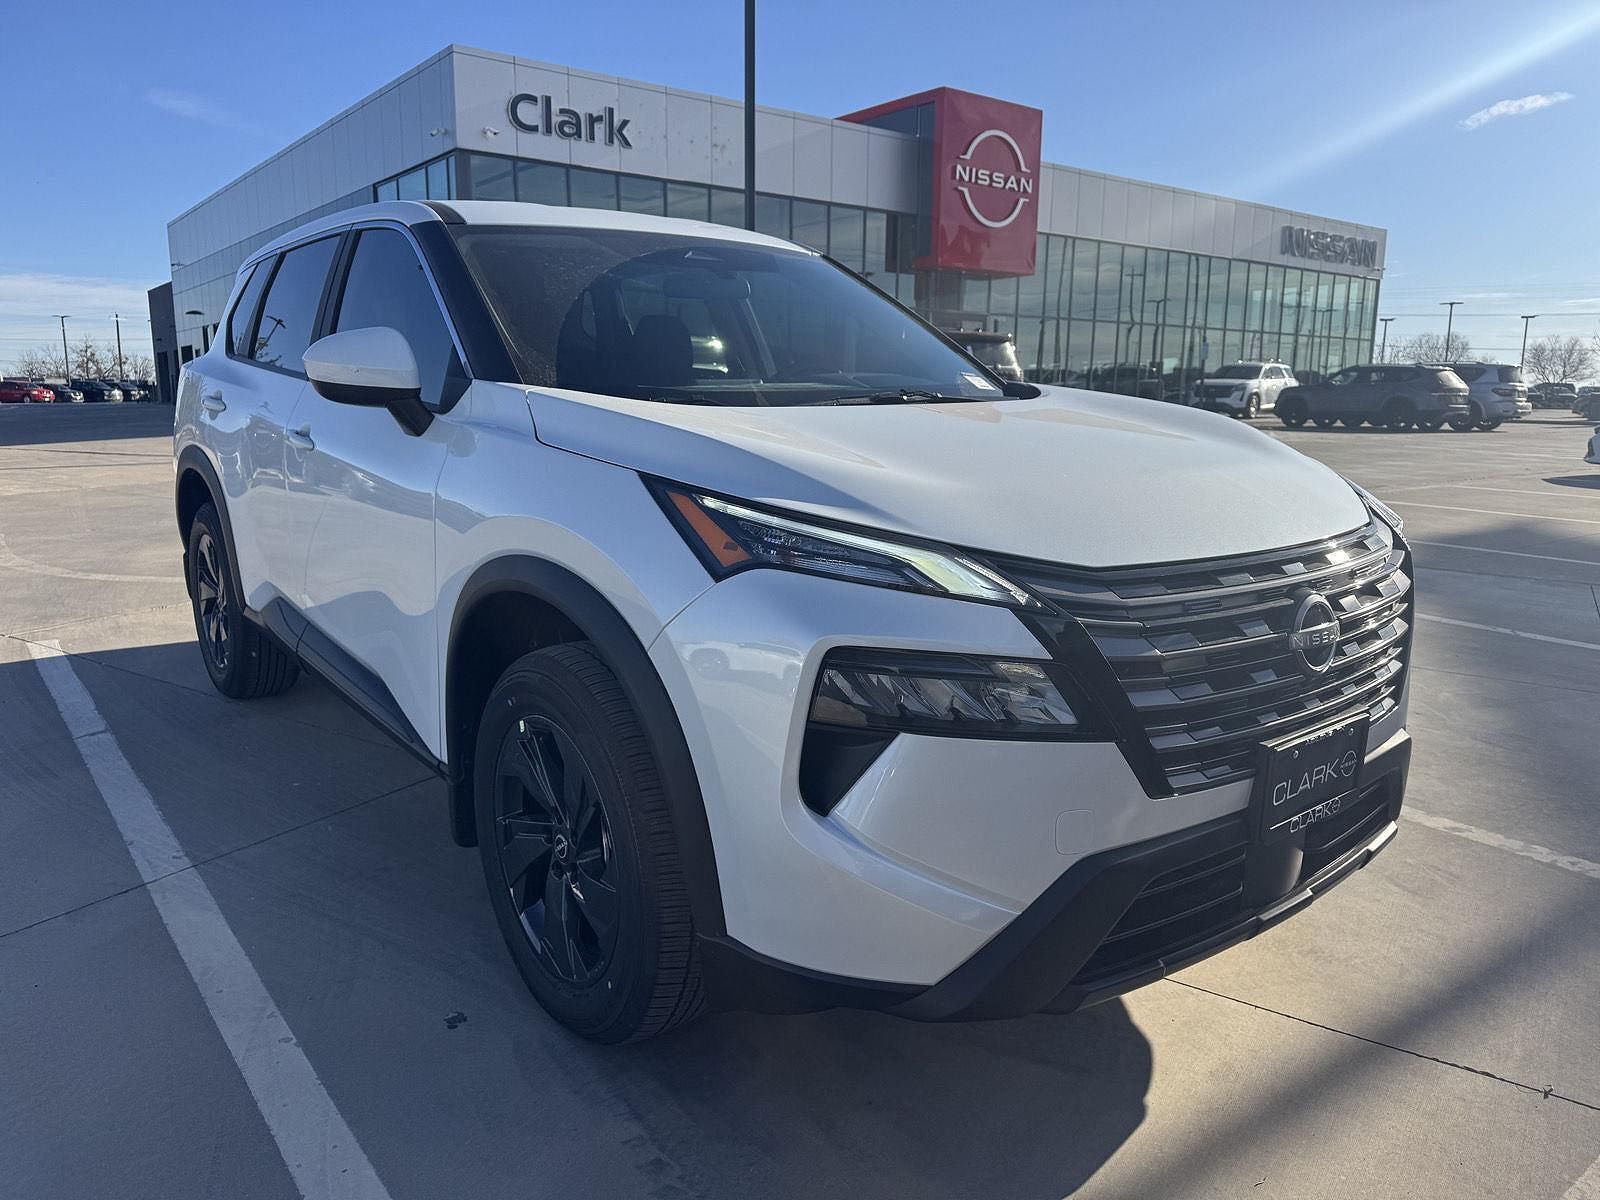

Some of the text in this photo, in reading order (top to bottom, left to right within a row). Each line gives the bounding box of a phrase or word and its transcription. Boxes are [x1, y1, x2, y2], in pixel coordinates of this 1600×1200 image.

[508, 93, 632, 149] Clark
[955, 164, 1033, 194] NISSAN
[1280, 225, 1378, 268] NISSAN
[1273, 758, 1339, 806] CLARK
[1290, 800, 1332, 833] CLARK
